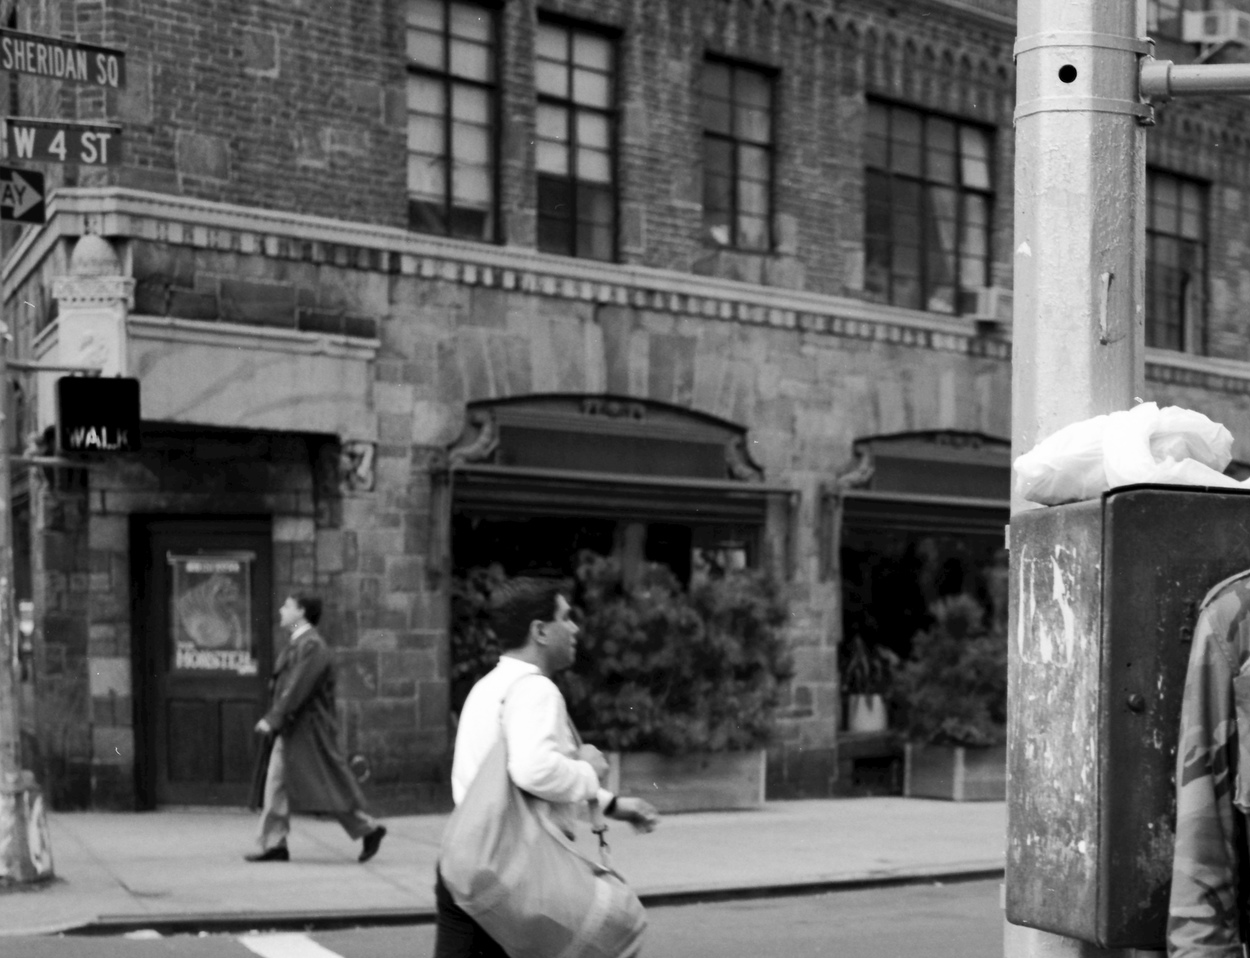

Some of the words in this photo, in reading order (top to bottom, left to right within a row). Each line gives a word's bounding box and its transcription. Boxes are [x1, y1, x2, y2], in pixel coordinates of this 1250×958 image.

[2, 37, 88, 81] SHERIDAN
[96, 53, 119, 88] SQ
[13, 126, 36, 159] W
[48, 130, 67, 161] 4
[80, 131, 112, 164] ST
[2, 182, 26, 206] AY
[67, 426, 129, 450] WALK
